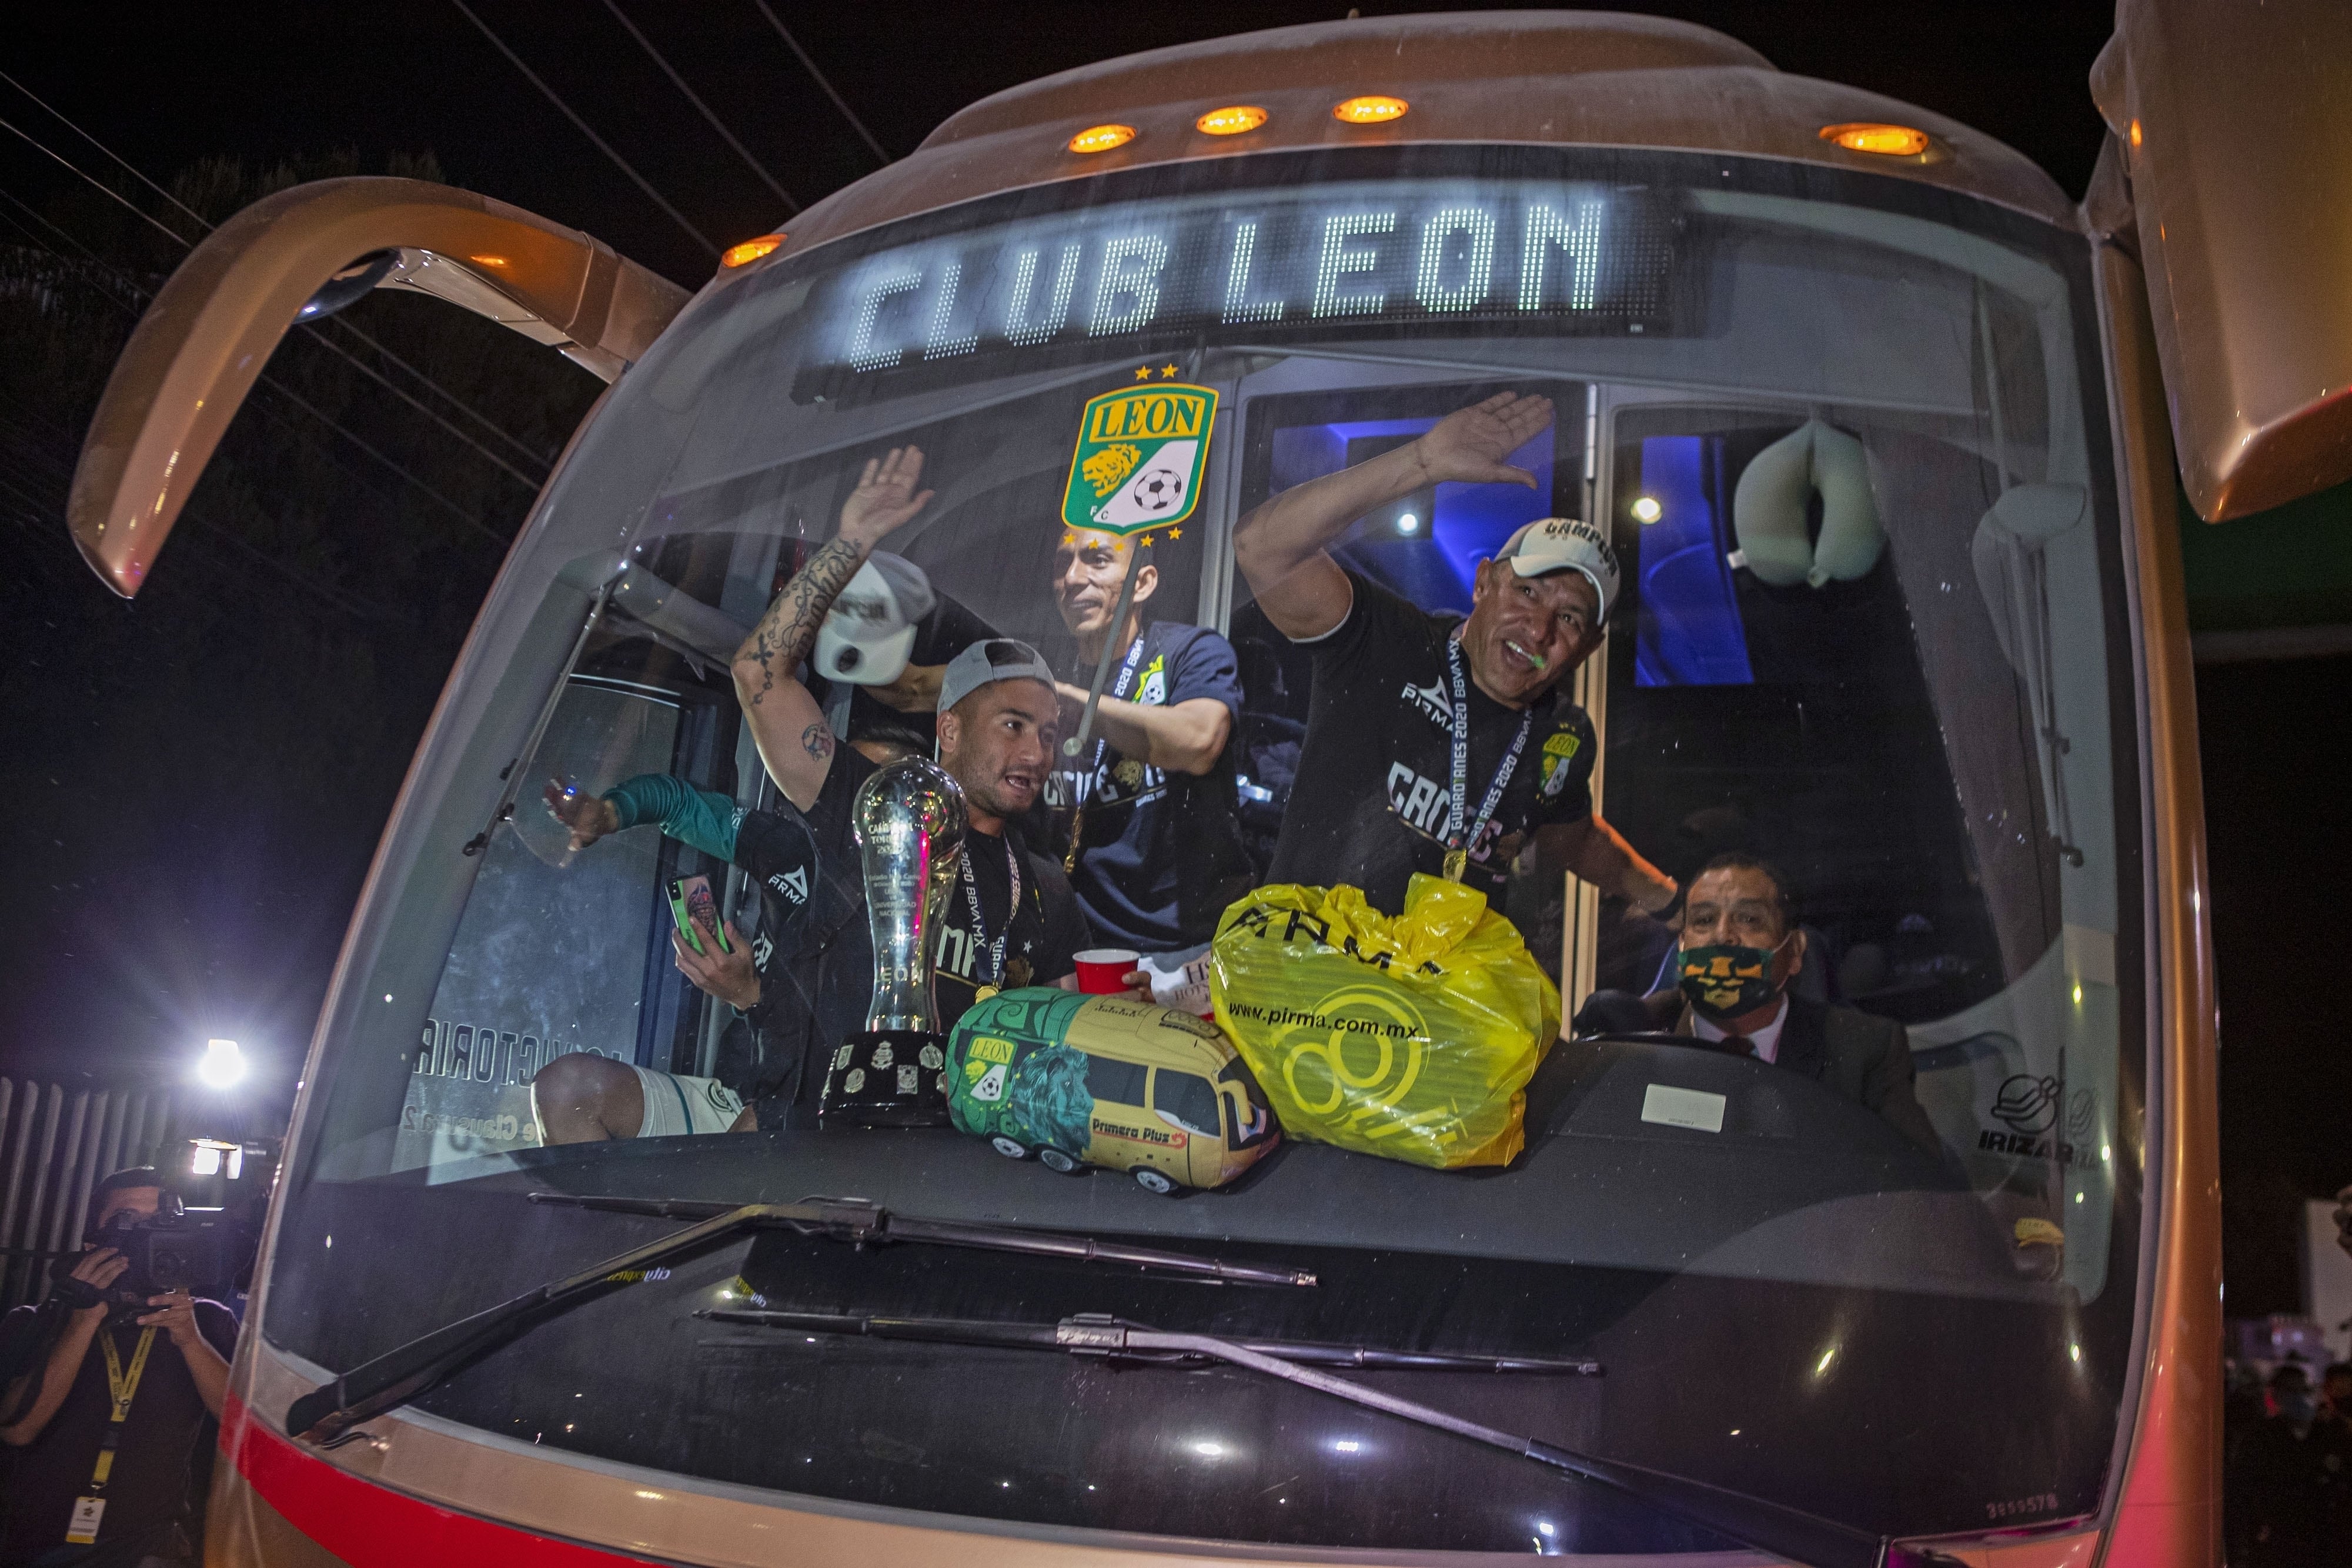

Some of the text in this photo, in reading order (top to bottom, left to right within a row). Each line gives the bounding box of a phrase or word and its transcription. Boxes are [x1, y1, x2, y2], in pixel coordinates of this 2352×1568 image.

[850, 204, 1602, 373] CLUB LEON
[1095, 397, 1201, 439] LEON
[1090, 505, 1109, 520] F C
[1114, 667, 1132, 697] 2020
[1451, 660, 1466, 698] BBVA
[1455, 703, 1467, 738] 2020
[1494, 754, 1518, 789] 2020
[966, 886, 981, 924] BBVA
[972, 923, 986, 948] MX
[1229, 1002, 1419, 1038] www.pirma.com.mx
[971, 1039, 1011, 1061] LEON
[1093, 1118, 1170, 1143] Primera Plus
[1977, 1129, 2073, 1163] IRIZAR
